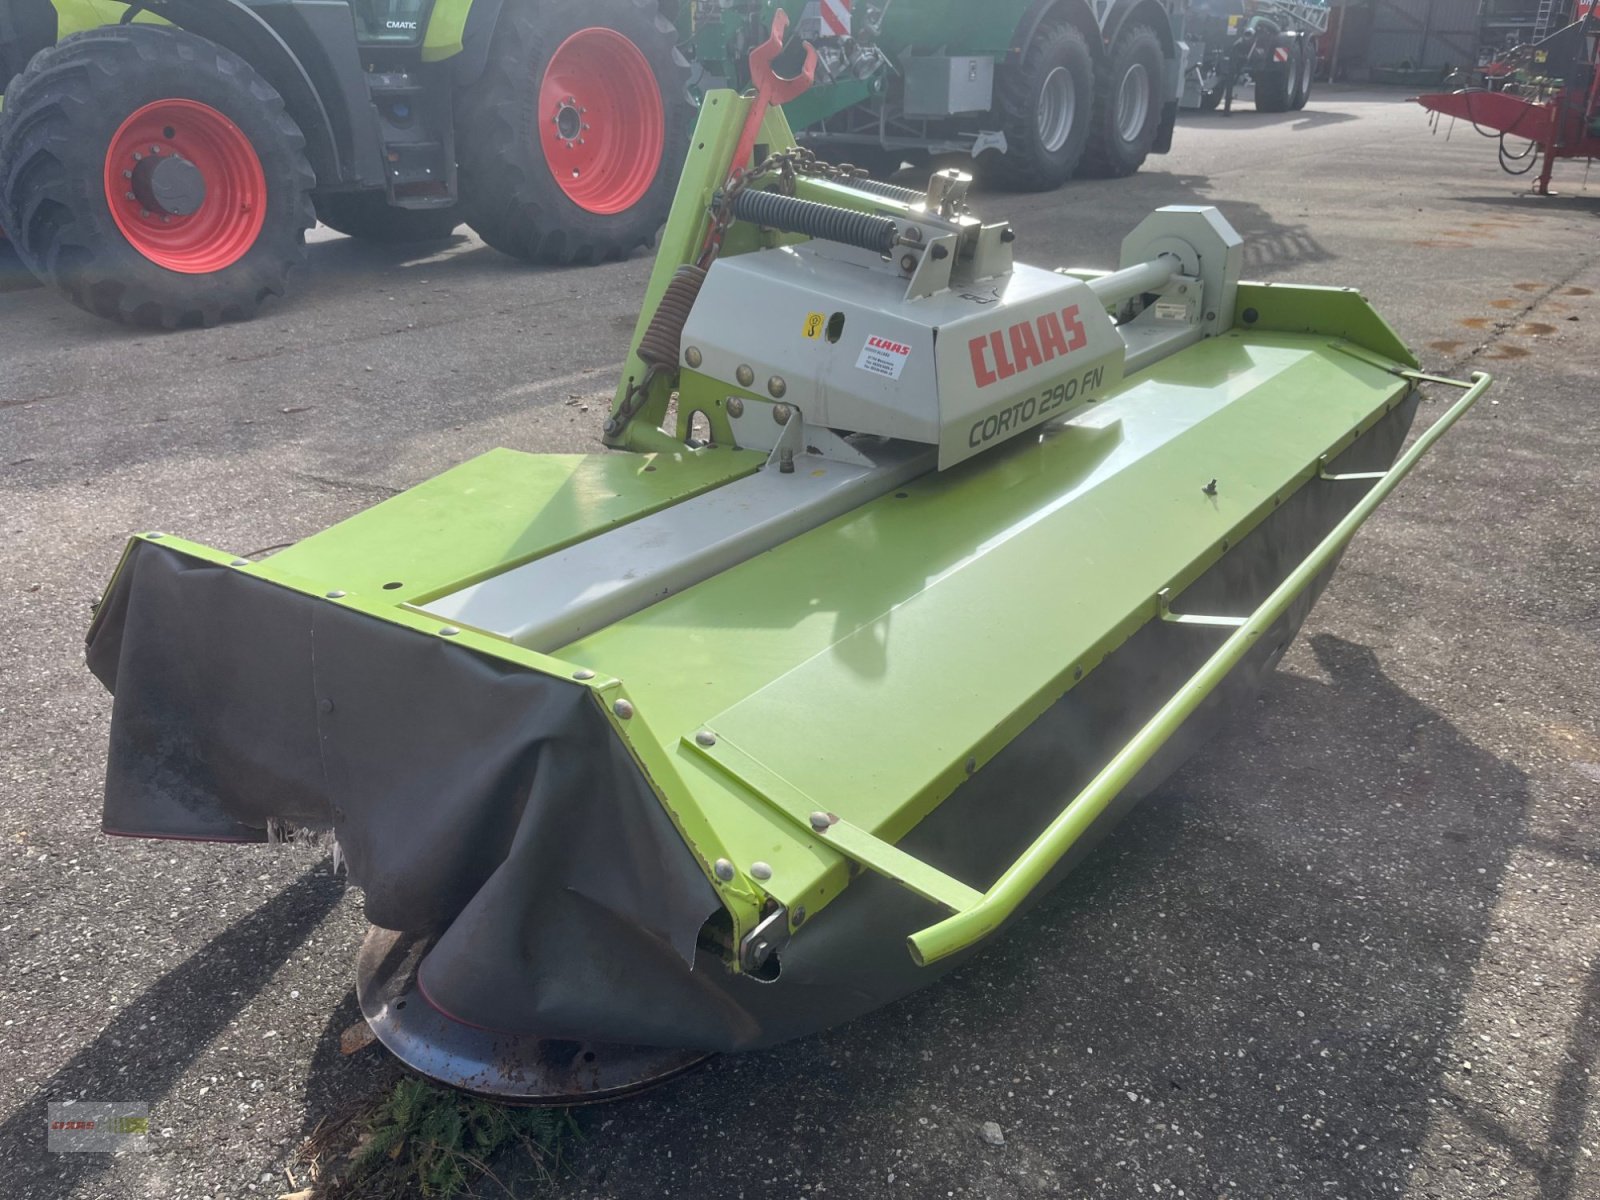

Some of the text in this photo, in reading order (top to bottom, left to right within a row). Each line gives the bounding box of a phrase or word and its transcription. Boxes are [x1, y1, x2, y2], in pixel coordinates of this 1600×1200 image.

[386, 20, 417, 29] CMATIC
[868, 336, 911, 356] CLAAS
[968, 304, 1088, 389] CLAAS
[968, 365, 1105, 449] CORTO 290 FN
